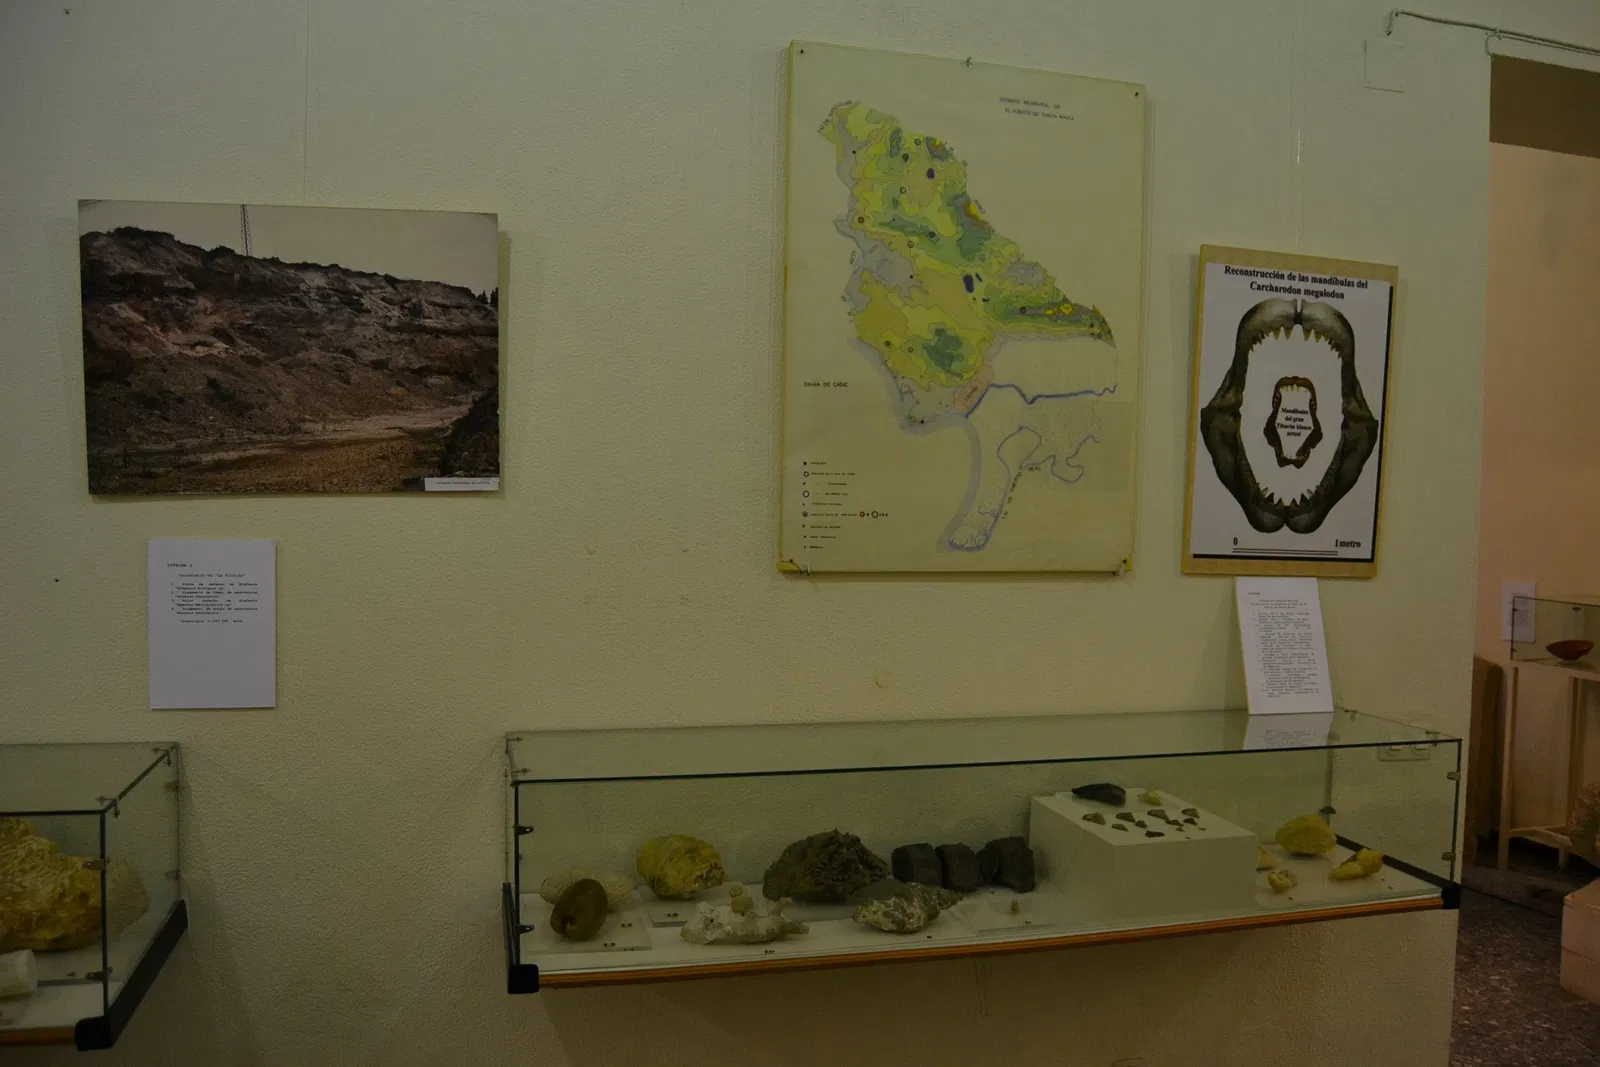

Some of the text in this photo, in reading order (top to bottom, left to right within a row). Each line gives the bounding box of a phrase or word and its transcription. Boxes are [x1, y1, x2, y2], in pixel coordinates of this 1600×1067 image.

[1224, 265, 1368, 289] Reconstrucción de las mandíbulas del
[1250, 281, 1345, 300] Carcharodon megalodon
[1233, 537, 1239, 546] 0
